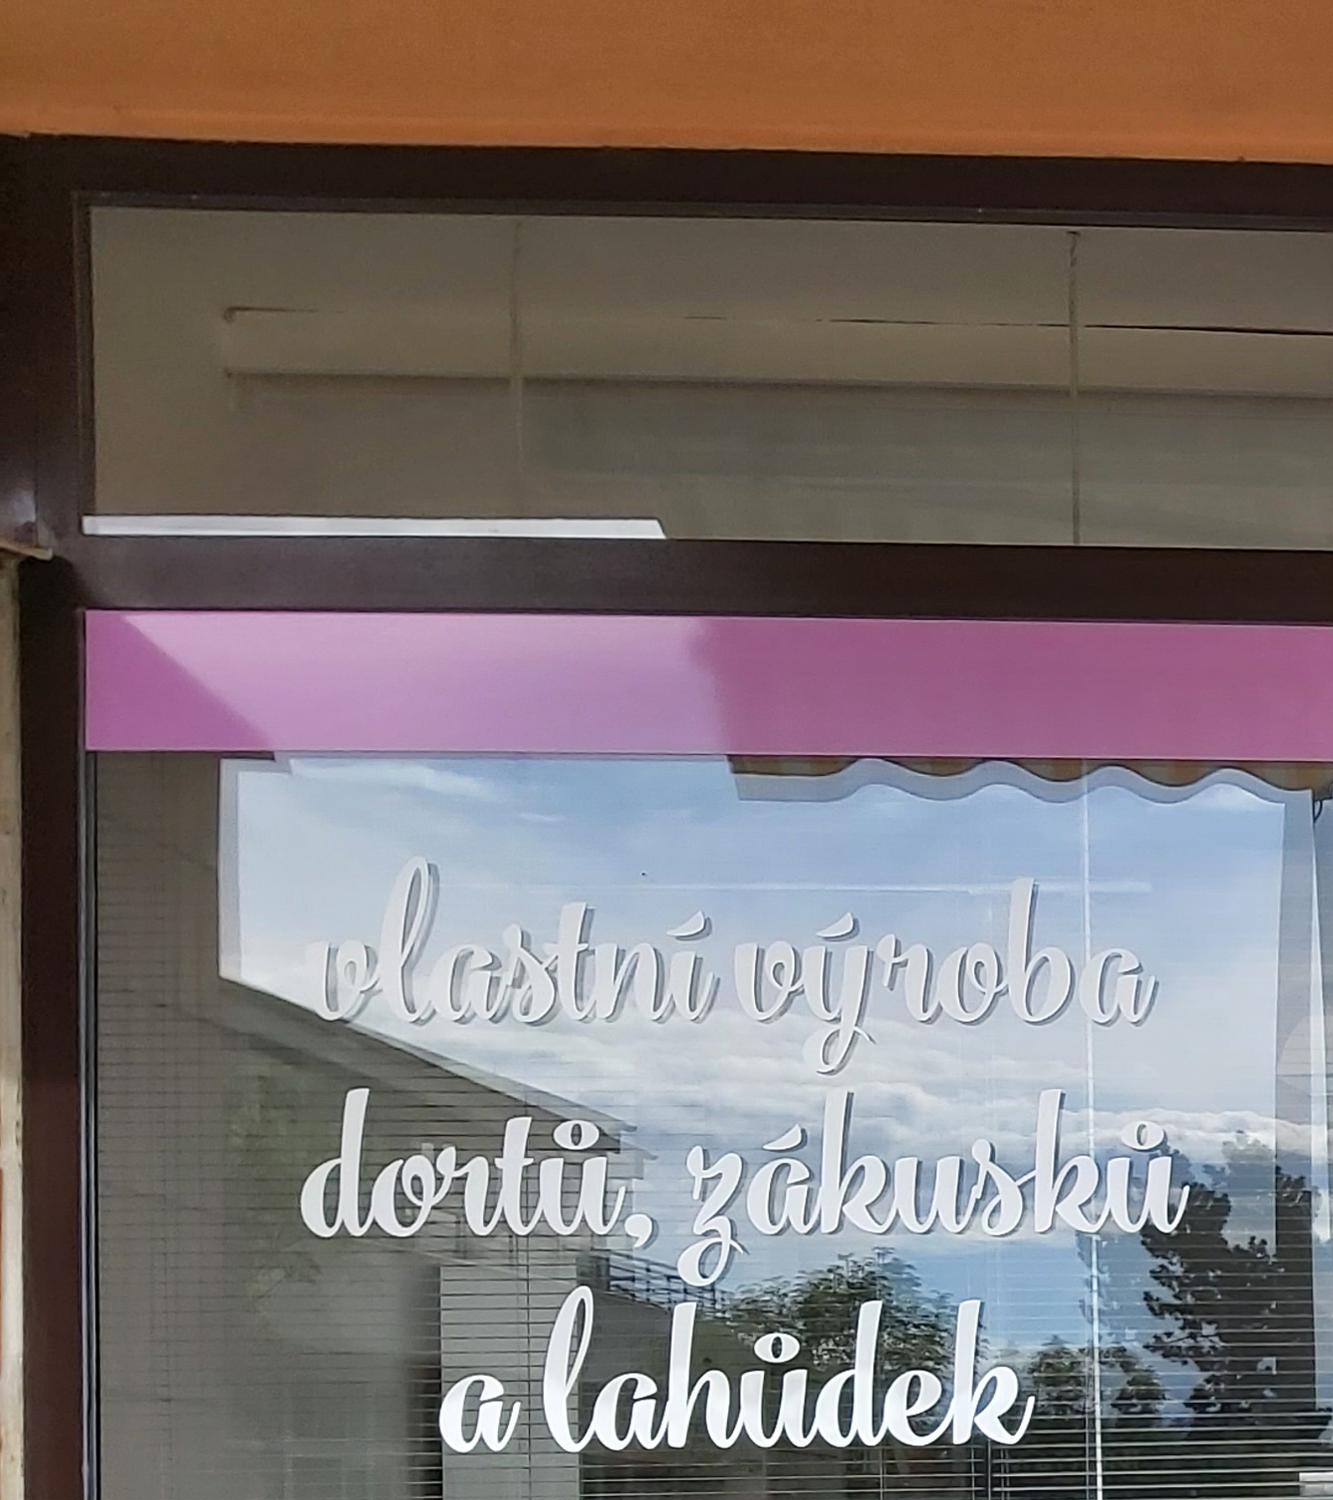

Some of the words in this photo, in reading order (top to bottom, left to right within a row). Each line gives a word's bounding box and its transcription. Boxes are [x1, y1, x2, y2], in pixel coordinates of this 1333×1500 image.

[314, 856, 718, 1026] vlastní
[735, 878, 1158, 1074] výroba
[299, 1088, 653, 1251] dortů,
[677, 1090, 1190, 1288] zákusků
[437, 1371, 522, 1455] a
[541, 1286, 1036, 1454] lahůdek
